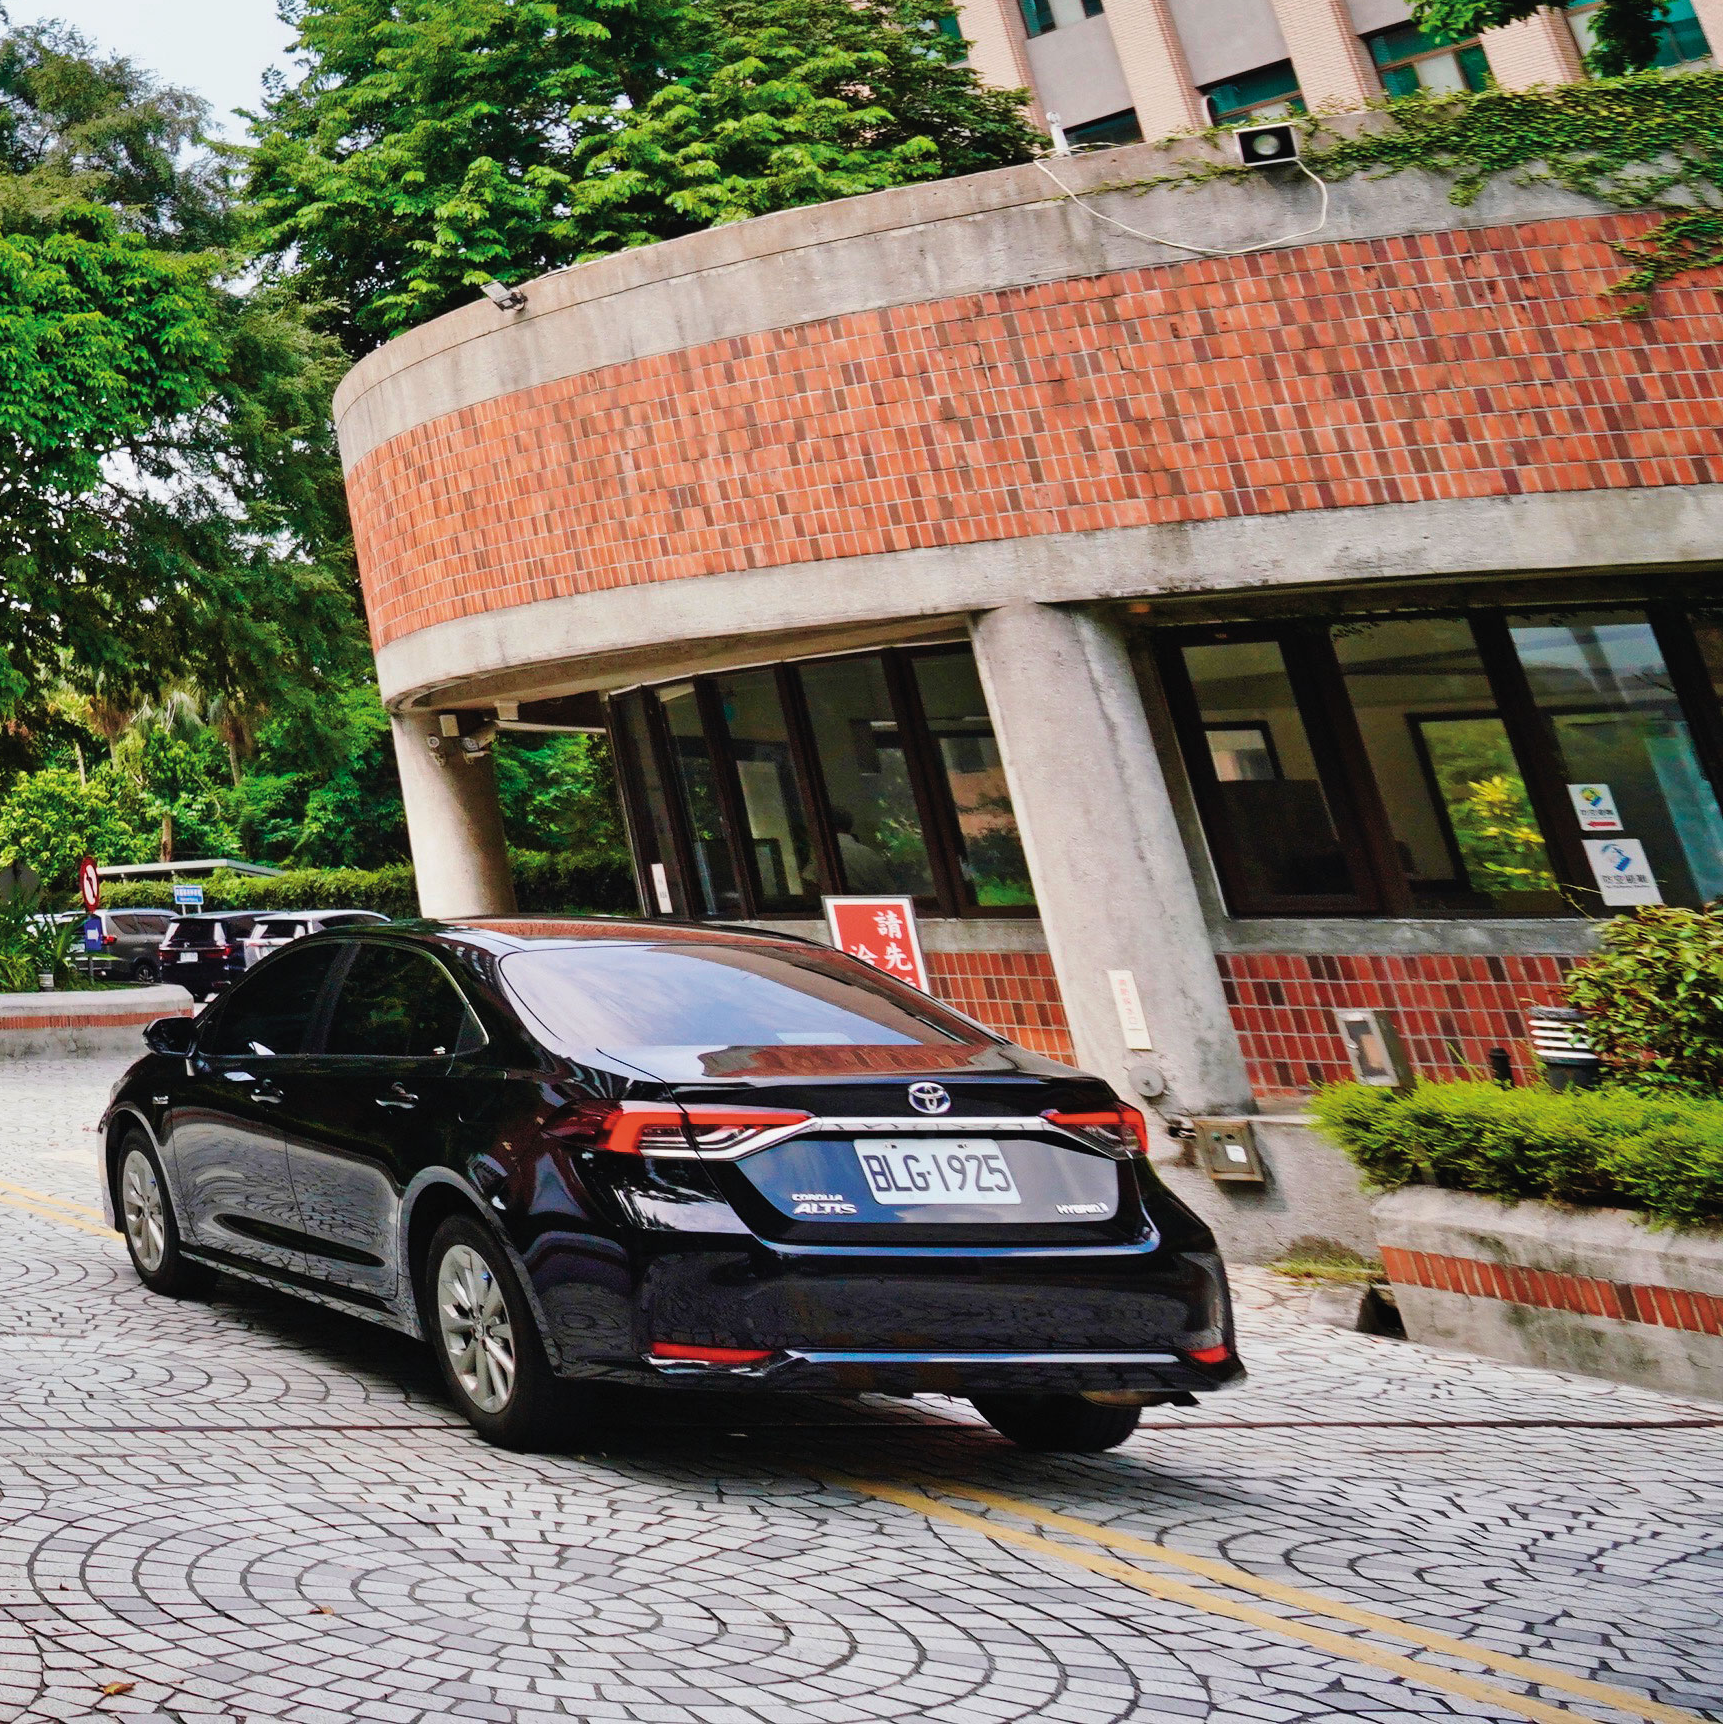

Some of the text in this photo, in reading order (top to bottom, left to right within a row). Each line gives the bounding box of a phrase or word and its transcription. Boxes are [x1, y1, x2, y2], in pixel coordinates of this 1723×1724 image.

[872, 909, 917, 986] 請先
[791, 1193, 844, 1202] COROLLA
[793, 1203, 858, 1215] ALTIS
[1055, 1203, 1105, 1215] HYBRID
